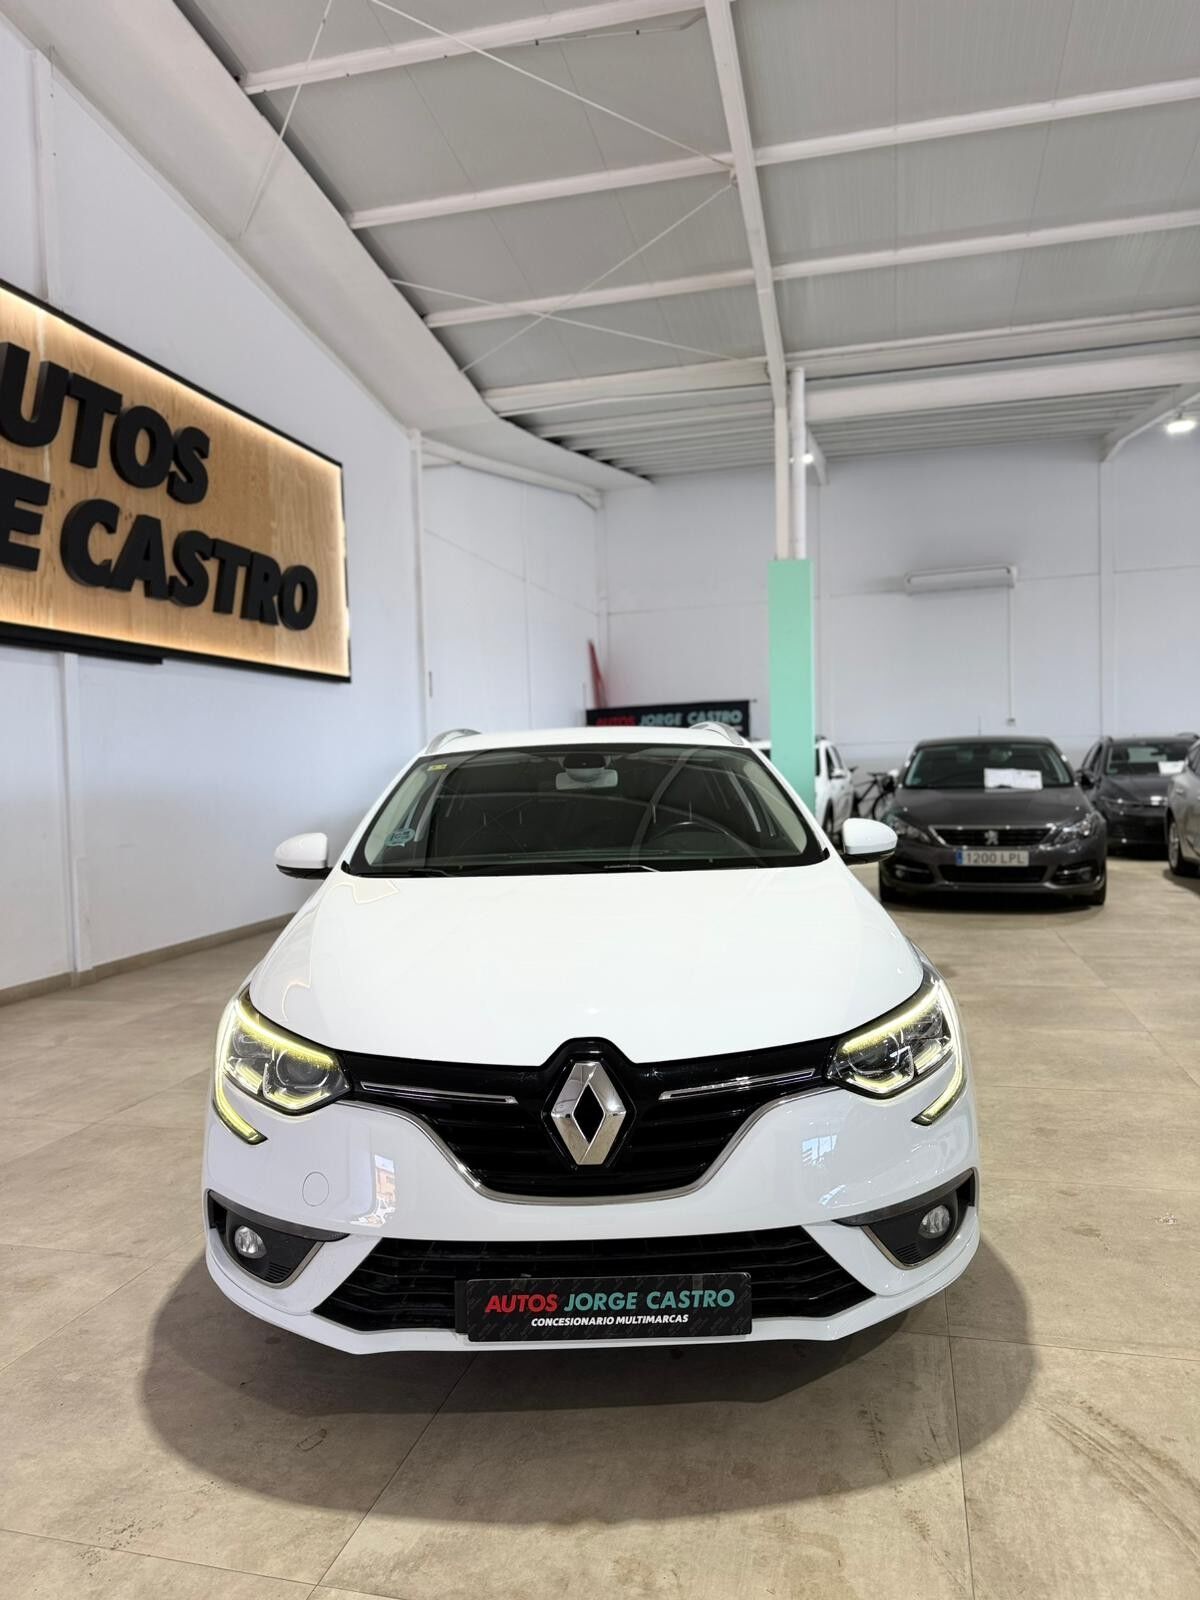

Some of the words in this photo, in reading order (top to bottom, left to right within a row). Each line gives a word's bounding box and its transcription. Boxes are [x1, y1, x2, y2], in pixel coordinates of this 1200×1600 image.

[60, 498, 318, 631] CASTRO
[639, 712, 682, 726] JORGE
[687, 710, 743, 724] CASTRO
[966, 852, 997, 864] 1200
[1000, 852, 1025, 864] LPL
[485, 1294, 558, 1313] AUTOS
[564, 1291, 637, 1312] JORGE
[646, 1289, 735, 1310] CASTRO
[531, 1316, 614, 1327] CONCESIONARIO
[615, 1314, 689, 1325] MULTIMARCAS
